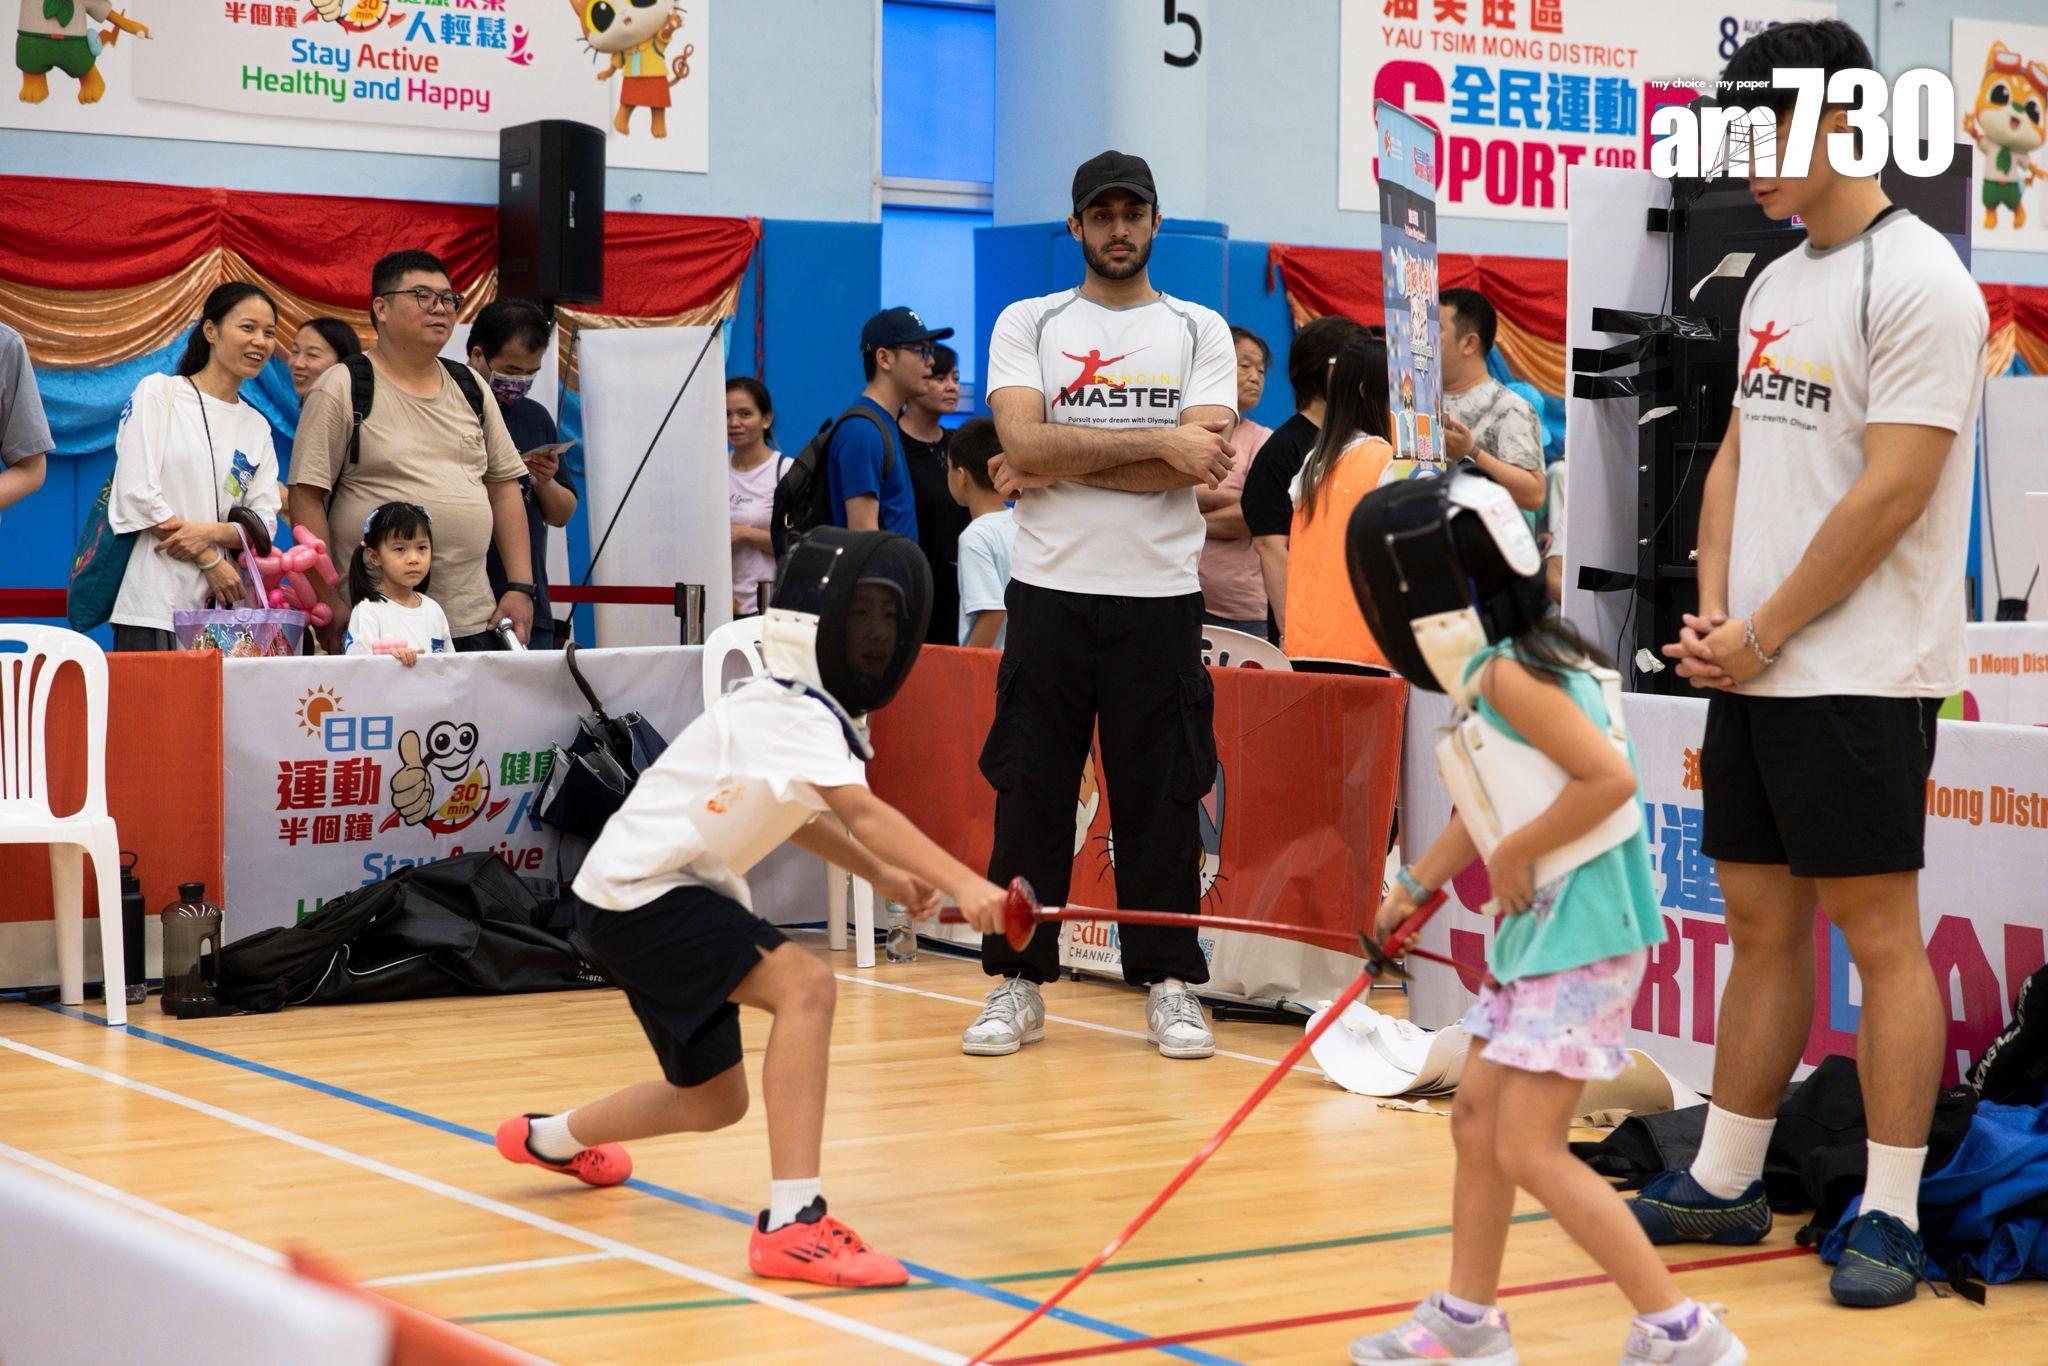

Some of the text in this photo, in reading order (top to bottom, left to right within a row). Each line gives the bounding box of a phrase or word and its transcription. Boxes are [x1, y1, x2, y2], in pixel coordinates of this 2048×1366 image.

[224, 2, 298, 28] 半個鐘
[355, 10, 374, 20] min
[405, 11, 507, 49] 人輕鬆
[1164, 0, 1203, 68] 5
[1381, 26, 1638, 69] YAU TSIM MONG DISTRICT
[1718, 16, 1740, 60] 8
[291, 38, 439, 73] Stay Active
[242, 65, 490, 113] Healthy and Happy
[1450, 65, 1638, 136] 全民運動
[1981, 654, 2019, 675] Mong
[324, 716, 394, 752] 日日
[275, 757, 382, 811] 運動
[450, 782, 479, 802] 30
[447, 802, 470, 816] min
[278, 813, 374, 847] 半個鐘
